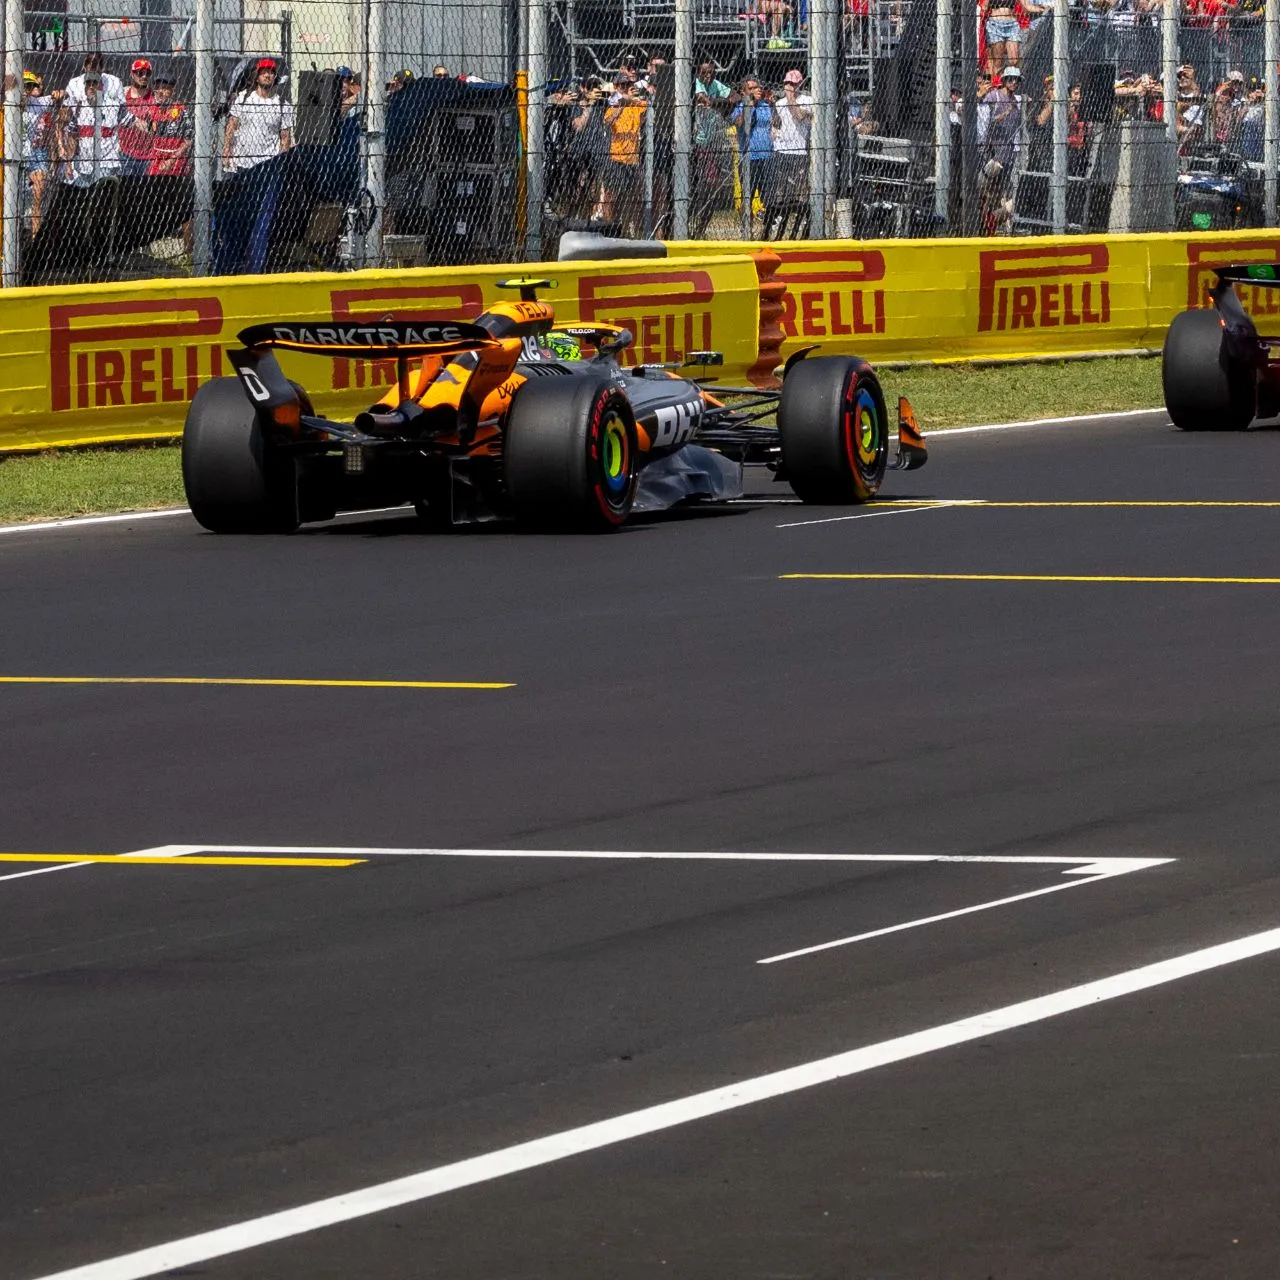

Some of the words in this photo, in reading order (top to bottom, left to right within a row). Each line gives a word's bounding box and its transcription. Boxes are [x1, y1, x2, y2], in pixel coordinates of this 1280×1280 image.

[979, 244, 1111, 333] PIRELLI
[50, 297, 225, 412] PIRELLI
[273, 326, 463, 346] DARKTRACE
